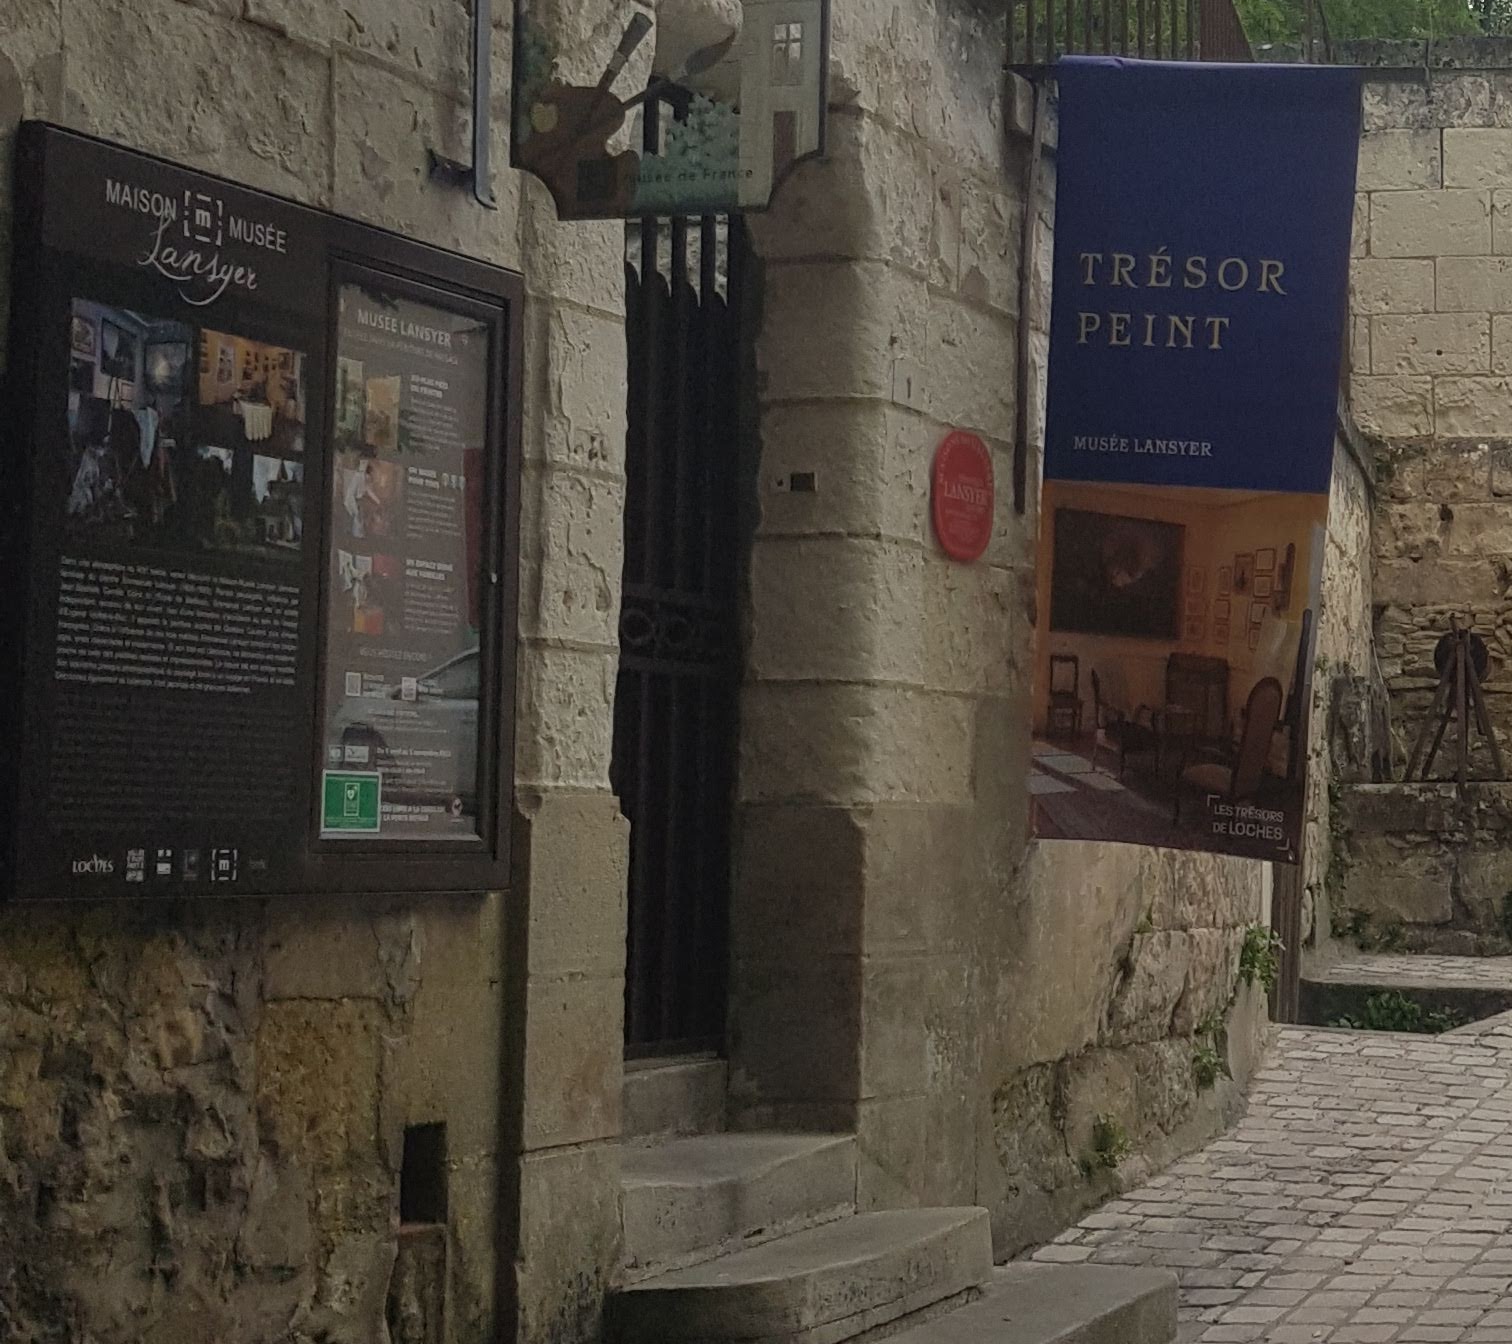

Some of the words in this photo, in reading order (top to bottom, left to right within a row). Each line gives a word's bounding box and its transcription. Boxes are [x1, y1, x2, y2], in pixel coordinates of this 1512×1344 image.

[703, 168, 752, 181] France
[105, 178, 177, 221] MAISON
[229, 215, 288, 254] MUSÉE
[136, 212, 258, 306] Lansyer
[1080, 246, 1287, 296] TRÉSOR
[400, 321, 452, 348] LANSYER
[1077, 312, 1230, 349] PEINT
[1073, 434, 1129, 453] MUSÉE
[1134, 438, 1212, 457] LANSYER
[944, 481, 988, 506] LANSYER
[1214, 804, 1233, 816] LES
[1235, 806, 1284, 822] TRÉSORS
[1213, 822, 1227, 834] DE
[1229, 821, 1283, 840] LOCHES
